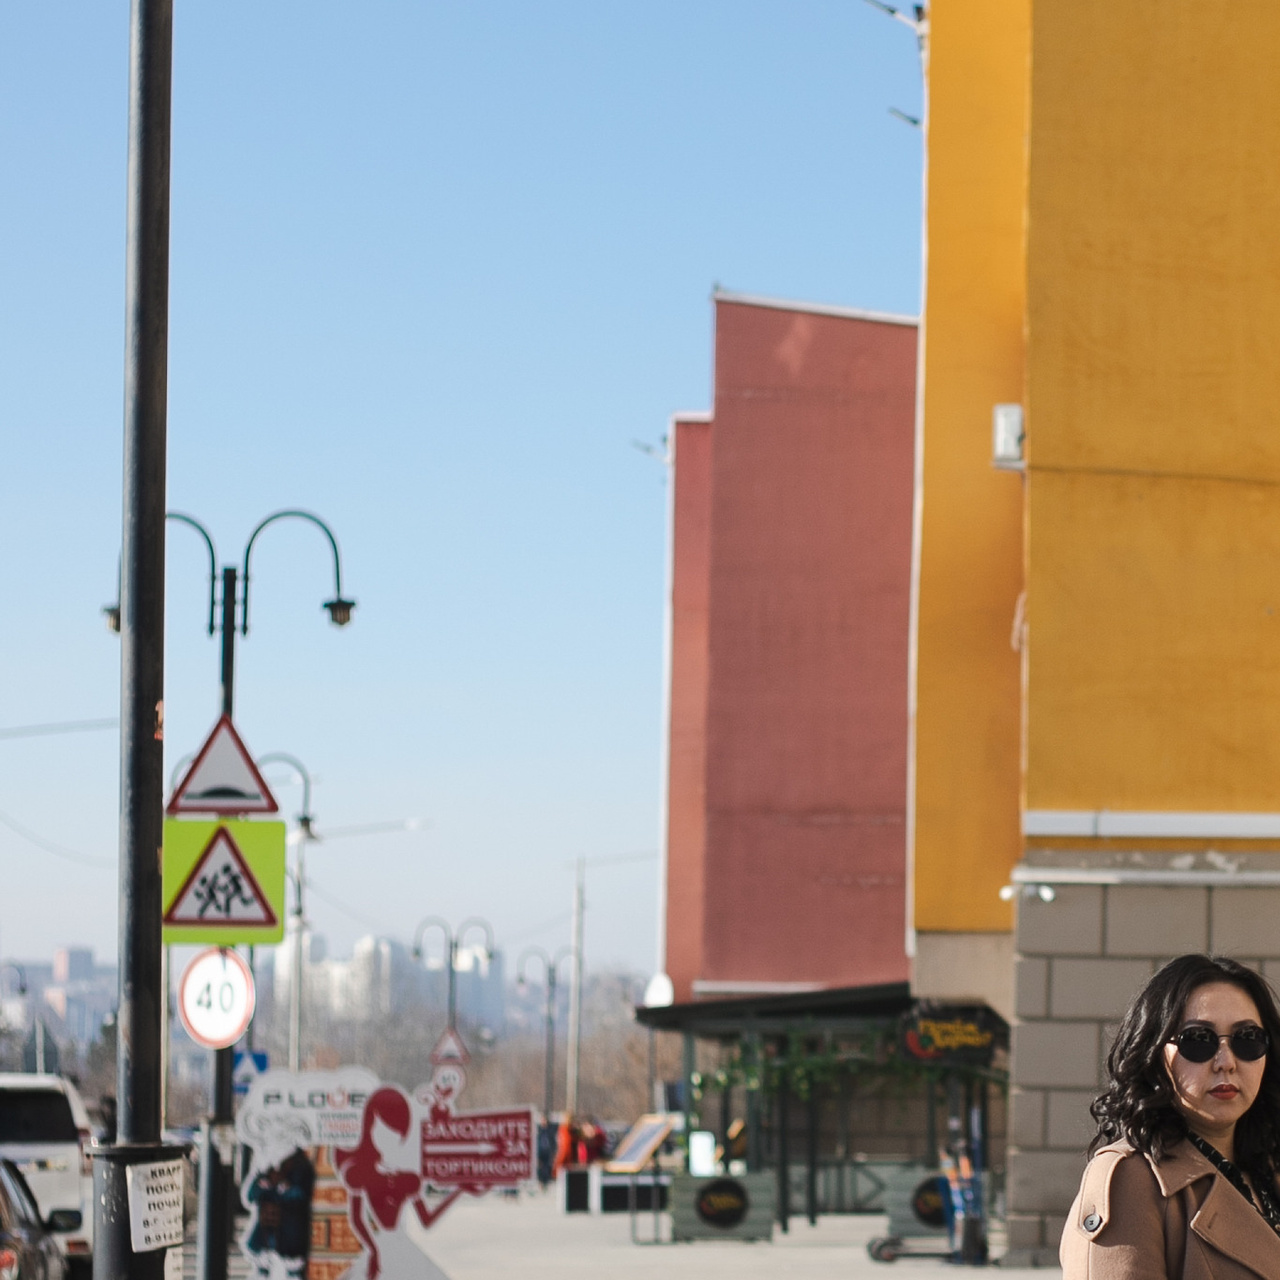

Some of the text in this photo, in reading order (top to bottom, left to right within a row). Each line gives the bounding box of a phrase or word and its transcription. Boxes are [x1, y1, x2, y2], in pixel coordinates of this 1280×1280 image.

[196, 982, 235, 1014] 40
[424, 1121, 529, 1140] ЗАХОДИТЕ
[503, 1140, 527, 1157] ЗА
